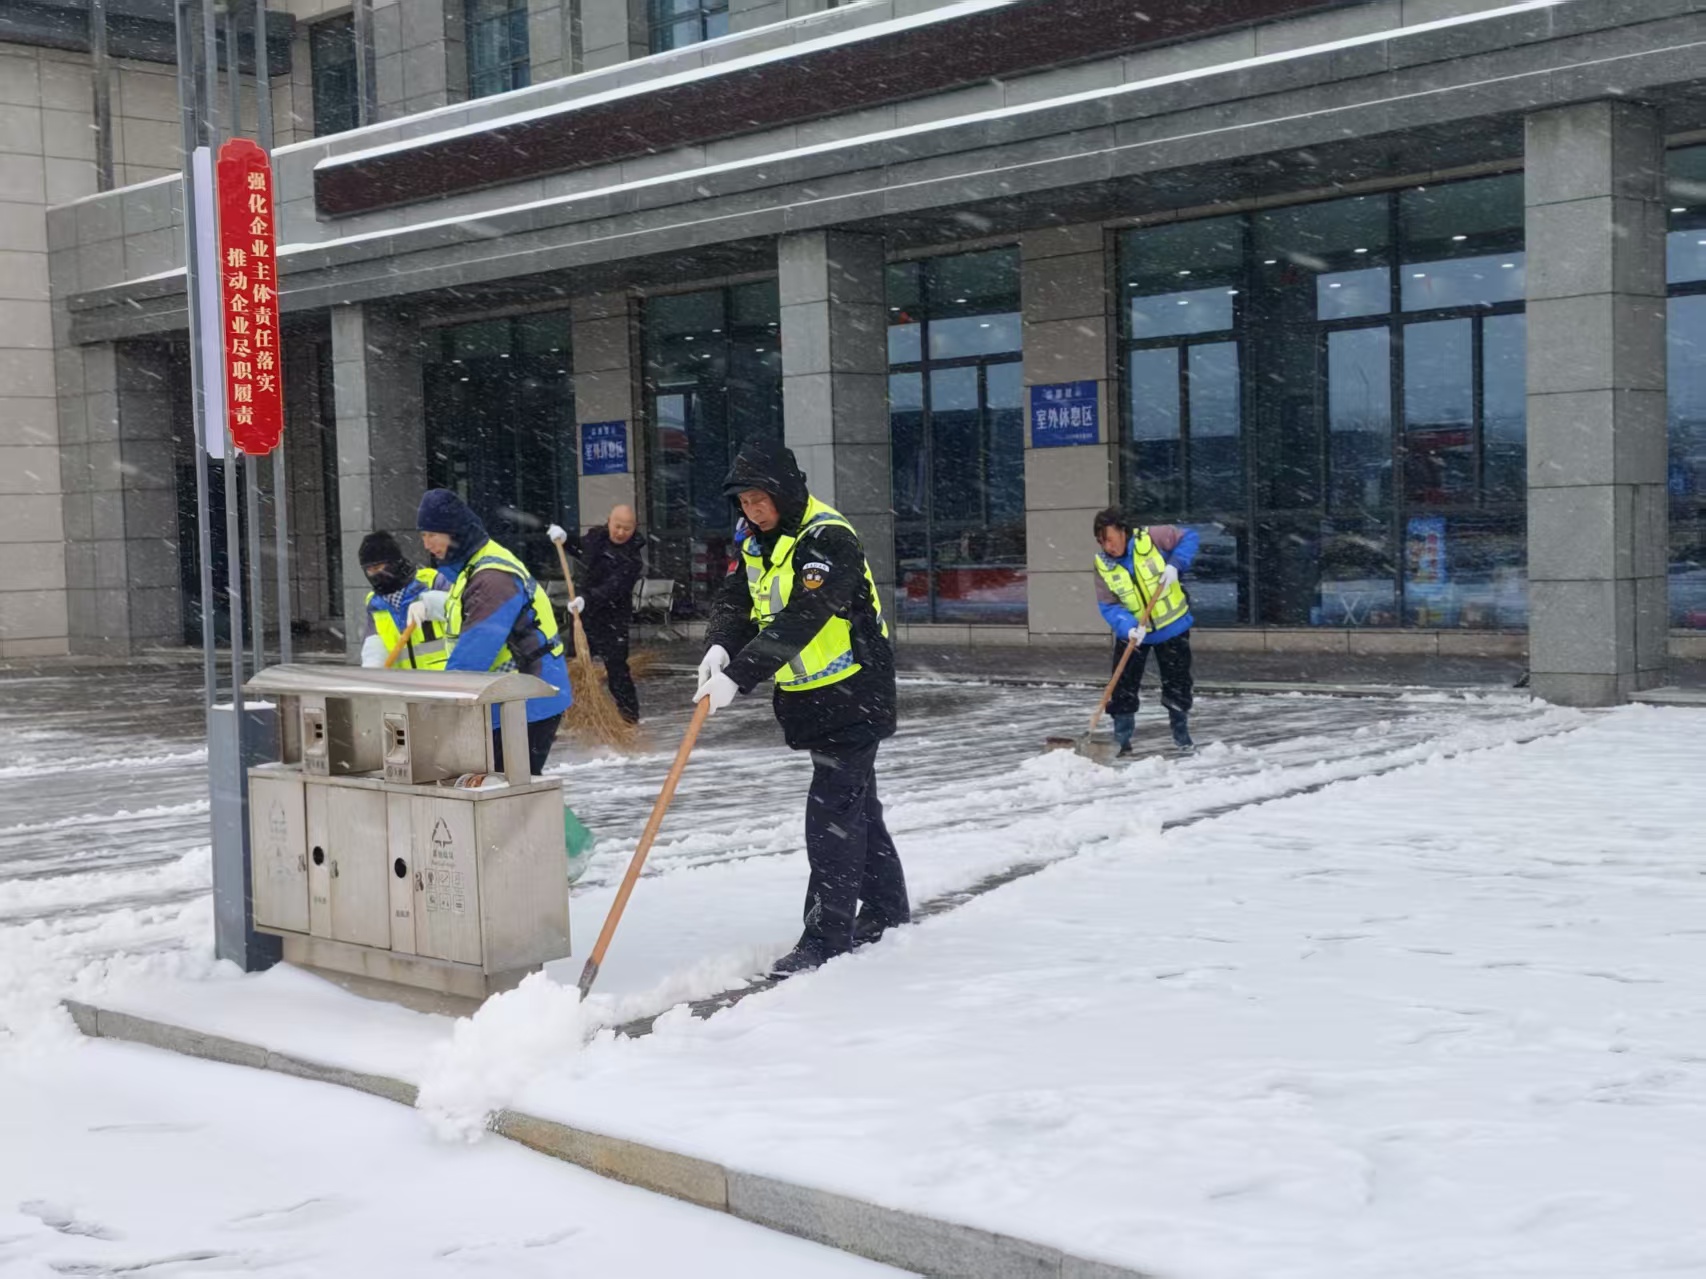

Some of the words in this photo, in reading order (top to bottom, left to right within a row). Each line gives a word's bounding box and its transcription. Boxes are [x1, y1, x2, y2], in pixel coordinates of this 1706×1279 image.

[227, 247, 254, 425] 推动企业尽职履责
[247, 172, 276, 393] 强化企业主体责任落实
[1036, 405, 1093, 430] 室外休息区
